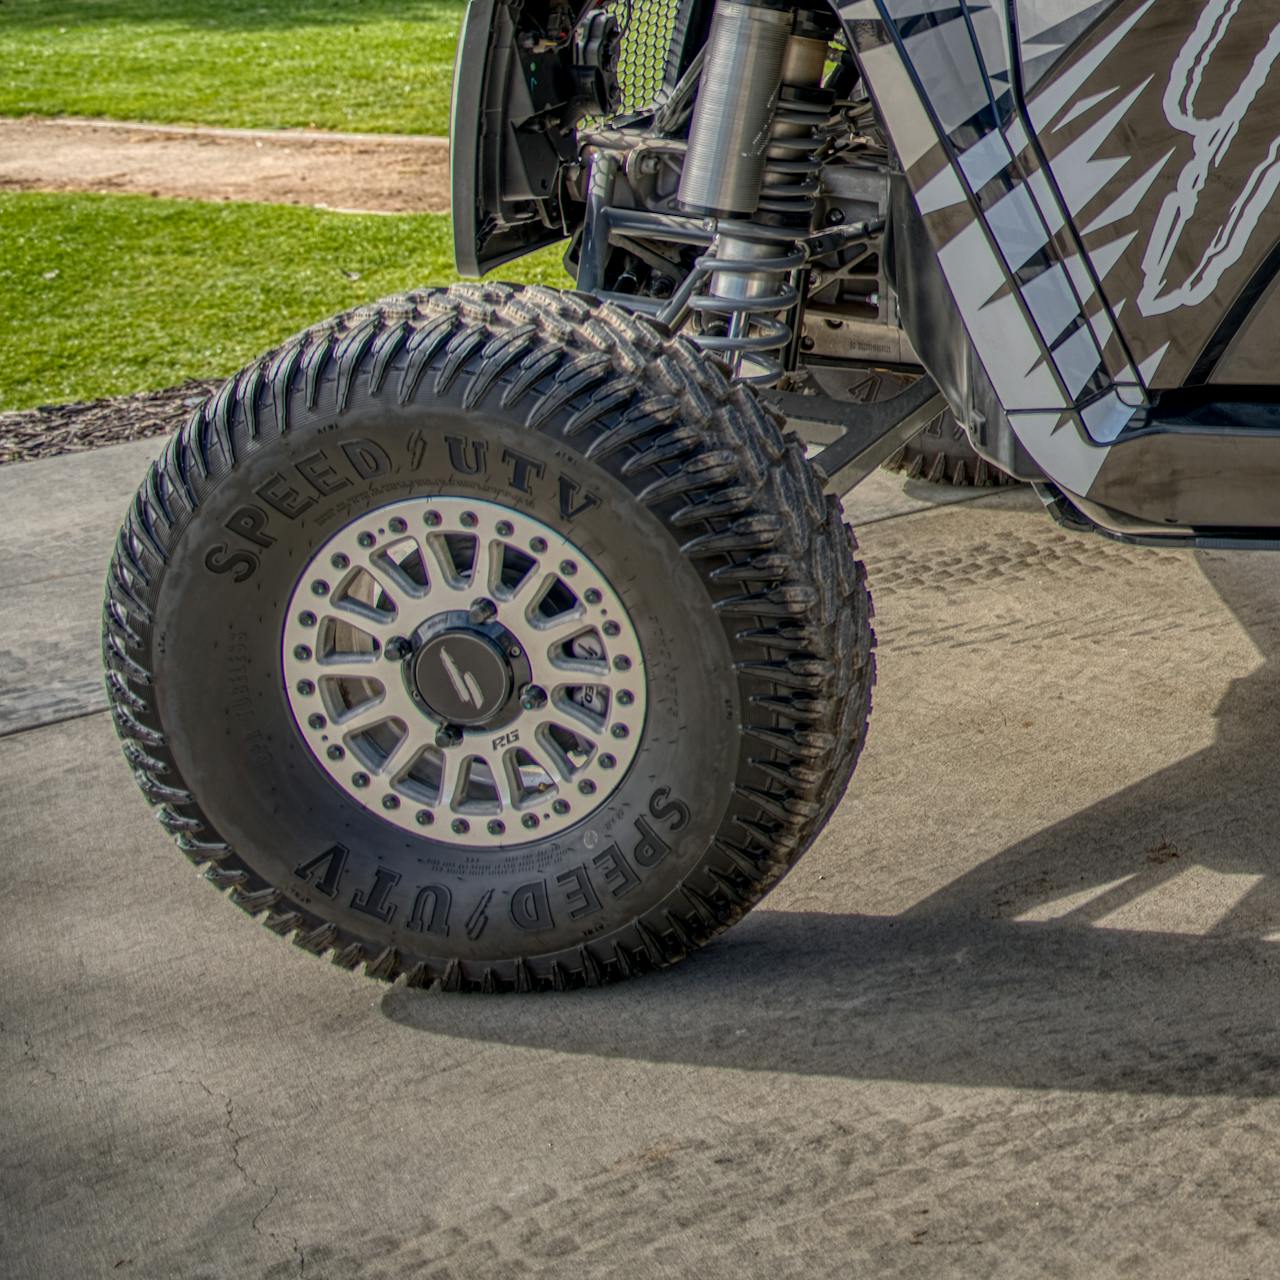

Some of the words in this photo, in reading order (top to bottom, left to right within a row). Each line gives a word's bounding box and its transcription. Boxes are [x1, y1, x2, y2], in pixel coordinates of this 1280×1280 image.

[203, 436, 394, 585] SPEED
[444, 432, 605, 524] UTV
[294, 841, 454, 939] UTV
[510, 784, 691, 933] SPEED
